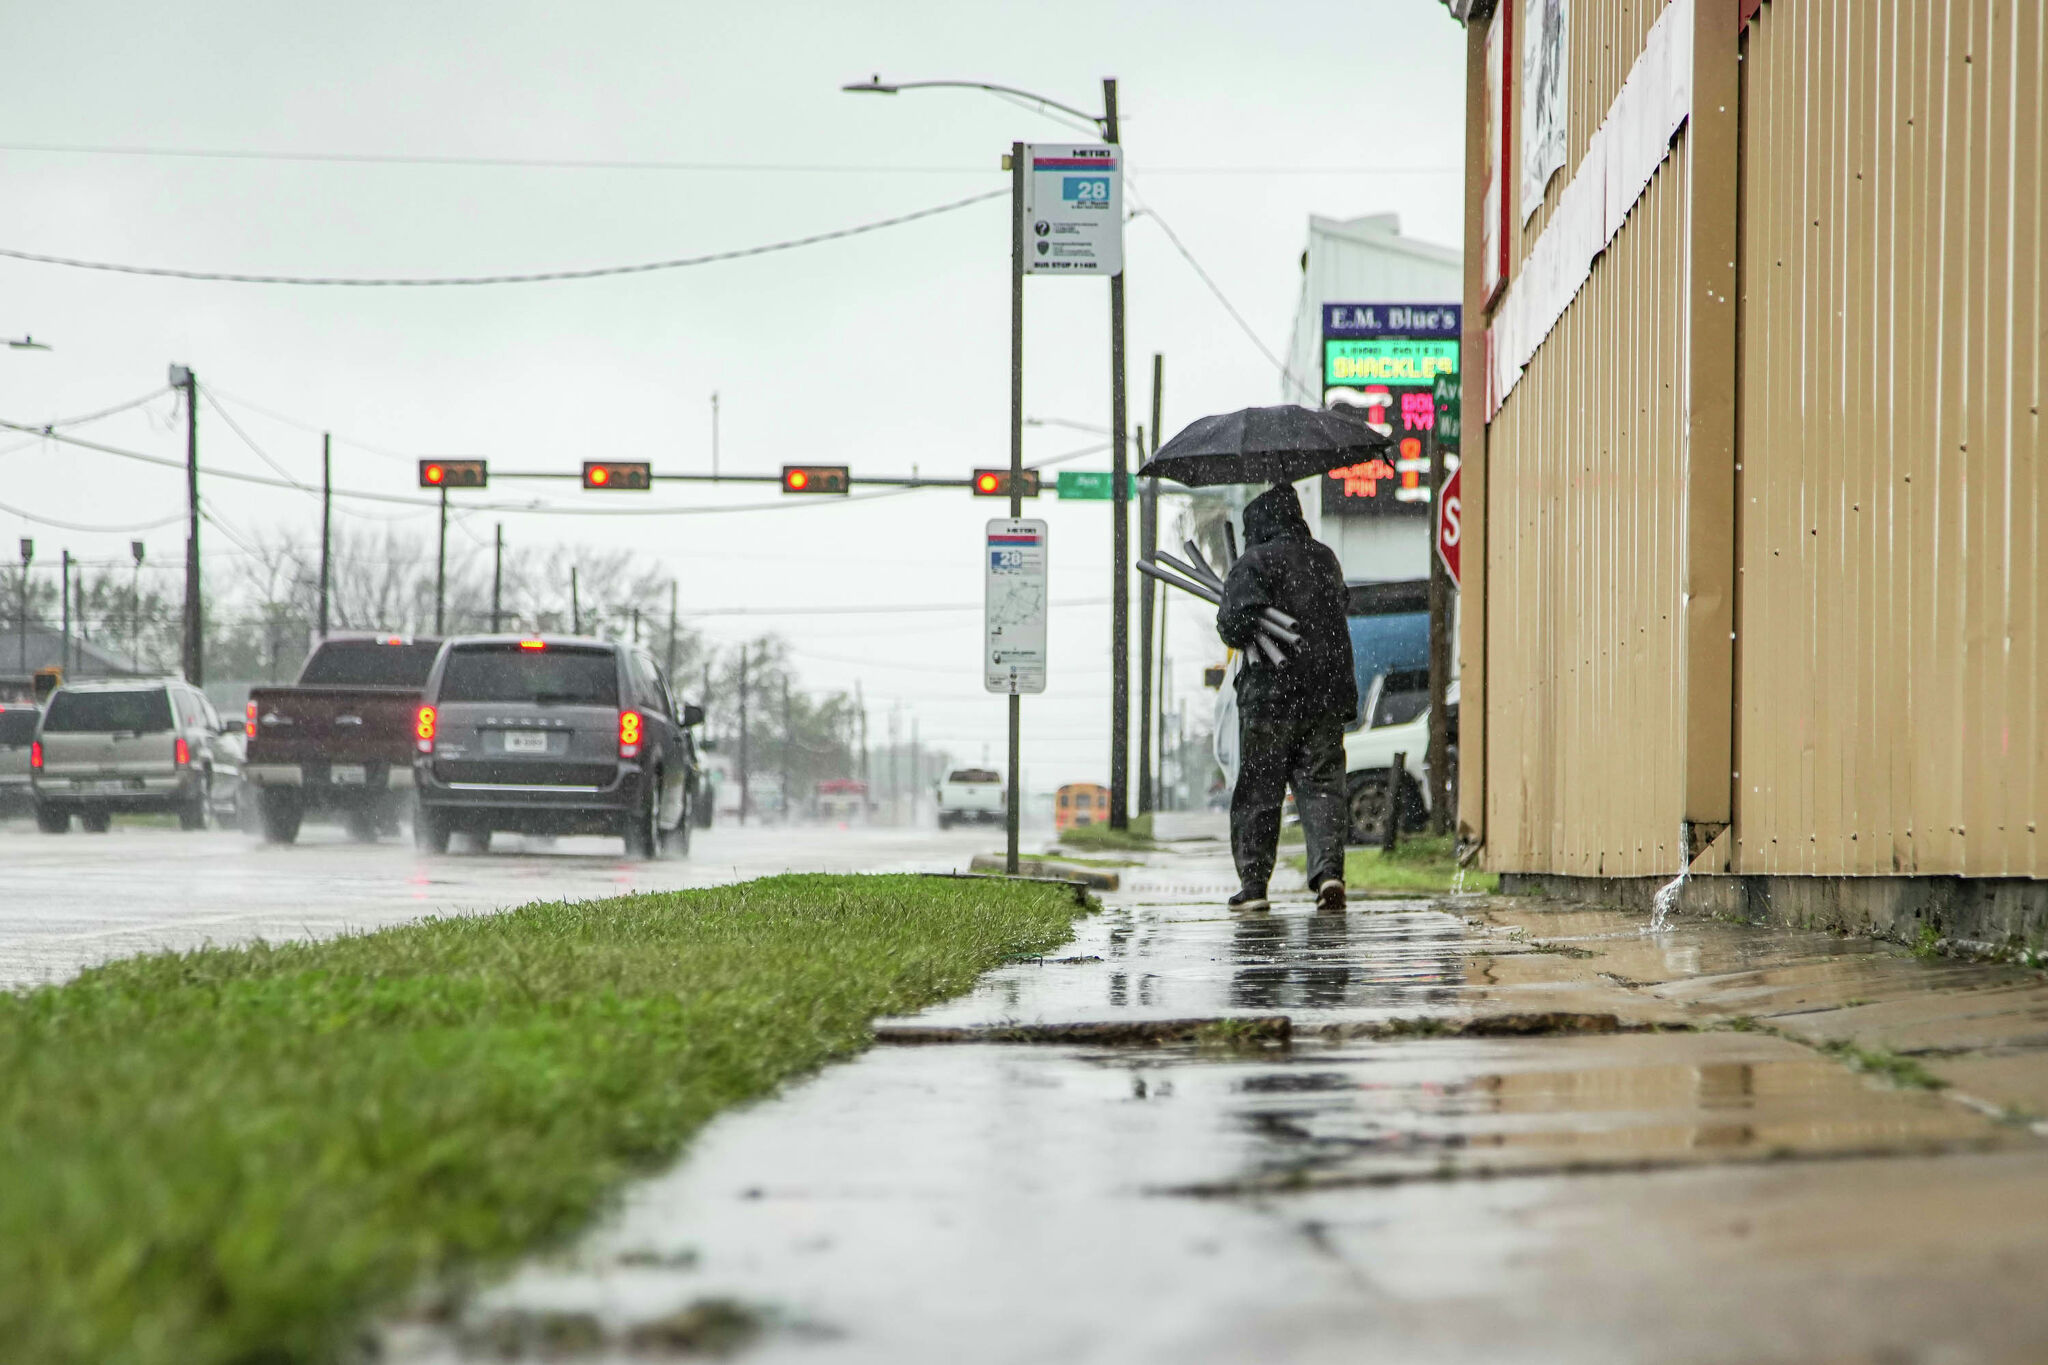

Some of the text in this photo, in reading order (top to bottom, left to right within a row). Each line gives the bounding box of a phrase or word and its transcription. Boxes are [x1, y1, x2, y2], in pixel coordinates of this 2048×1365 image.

[1072, 149, 1111, 158] METRO
[1078, 181, 1106, 199] 28
[1331, 307, 1456, 329] E.M. Blue's
[1401, 393, 1434, 412] BOL
[1000, 553, 1020, 566] 28
